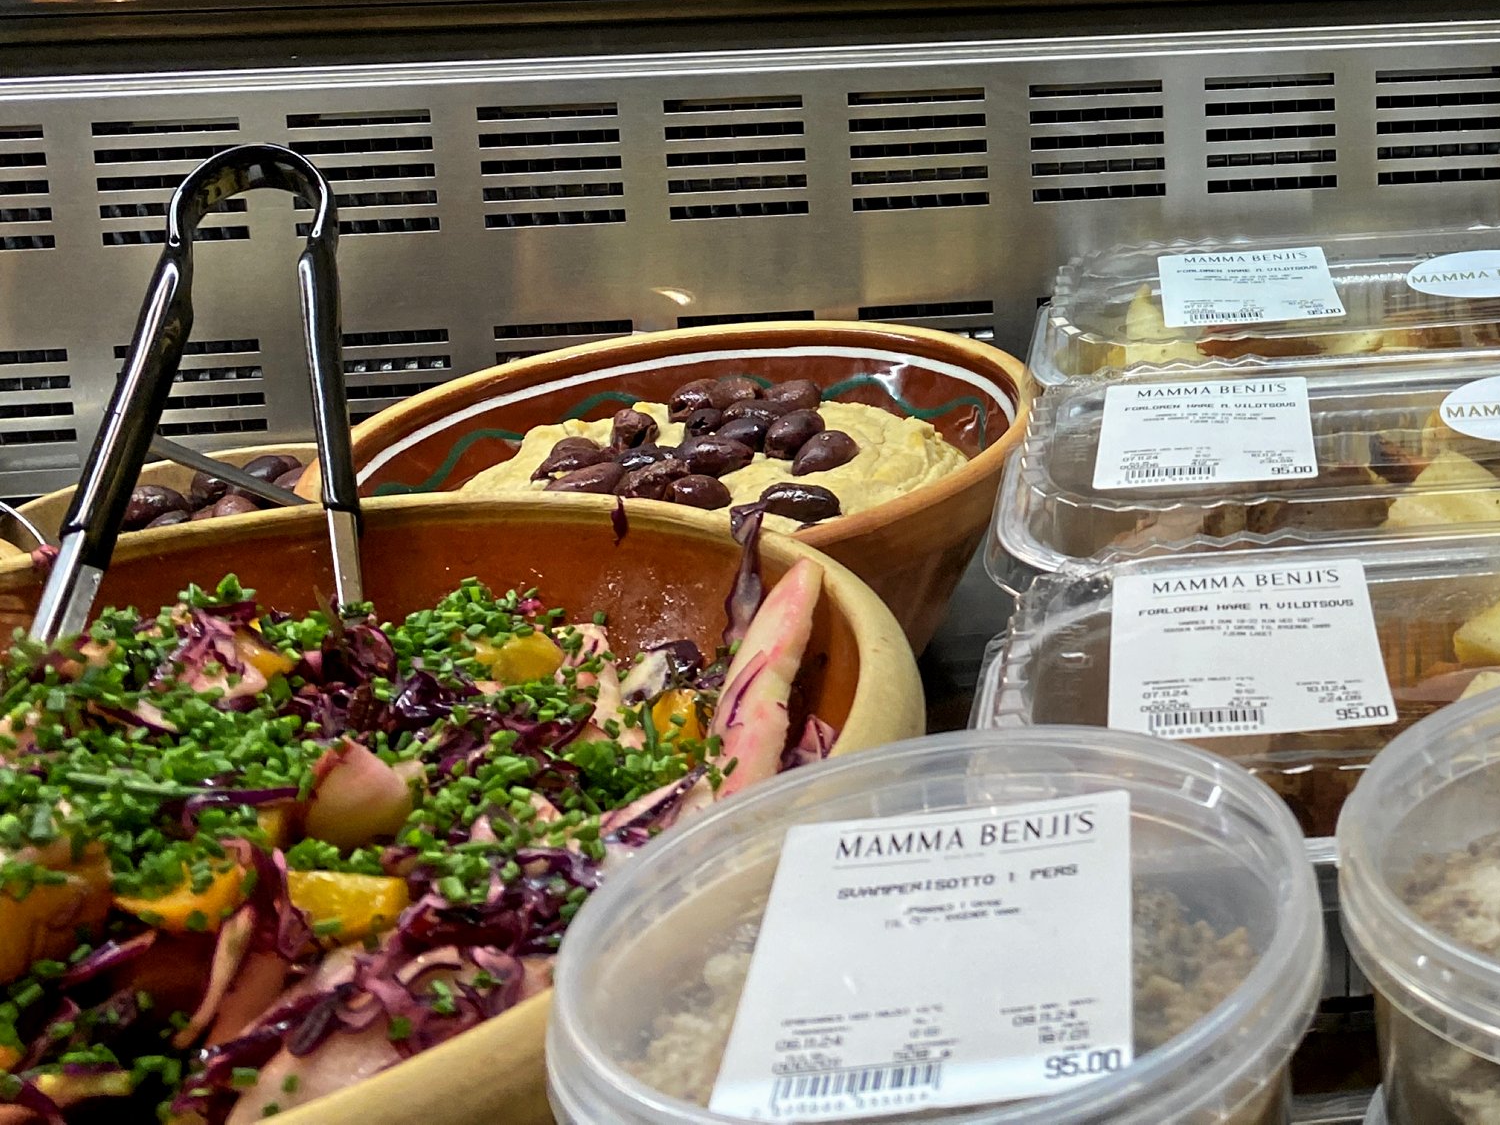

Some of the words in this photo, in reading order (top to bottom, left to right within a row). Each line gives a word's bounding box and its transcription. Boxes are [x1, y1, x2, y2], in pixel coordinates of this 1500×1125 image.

[1184, 256, 1246, 264] MAMMA
[1412, 271, 1489, 284] MAMMA
[1137, 386, 1211, 398] MAMMA
[1220, 383, 1287, 394] BENJI'S
[1271, 465, 1313, 475] 95.00
[1152, 575, 1245, 594] MAMMA
[1256, 569, 1339, 587] BENJI'S
[1139, 604, 1208, 616] FORLOREN
[1216, 603, 1250, 611] HARE
[1336, 705, 1389, 721] 95.00
[836, 827, 964, 860] MAMMA
[980, 810, 1095, 846] BENJI'S
[837, 874, 996, 901] SVAMPERISOTTO
[1029, 863, 1079, 880] PERS
[1044, 1048, 1121, 1079] 95.00
